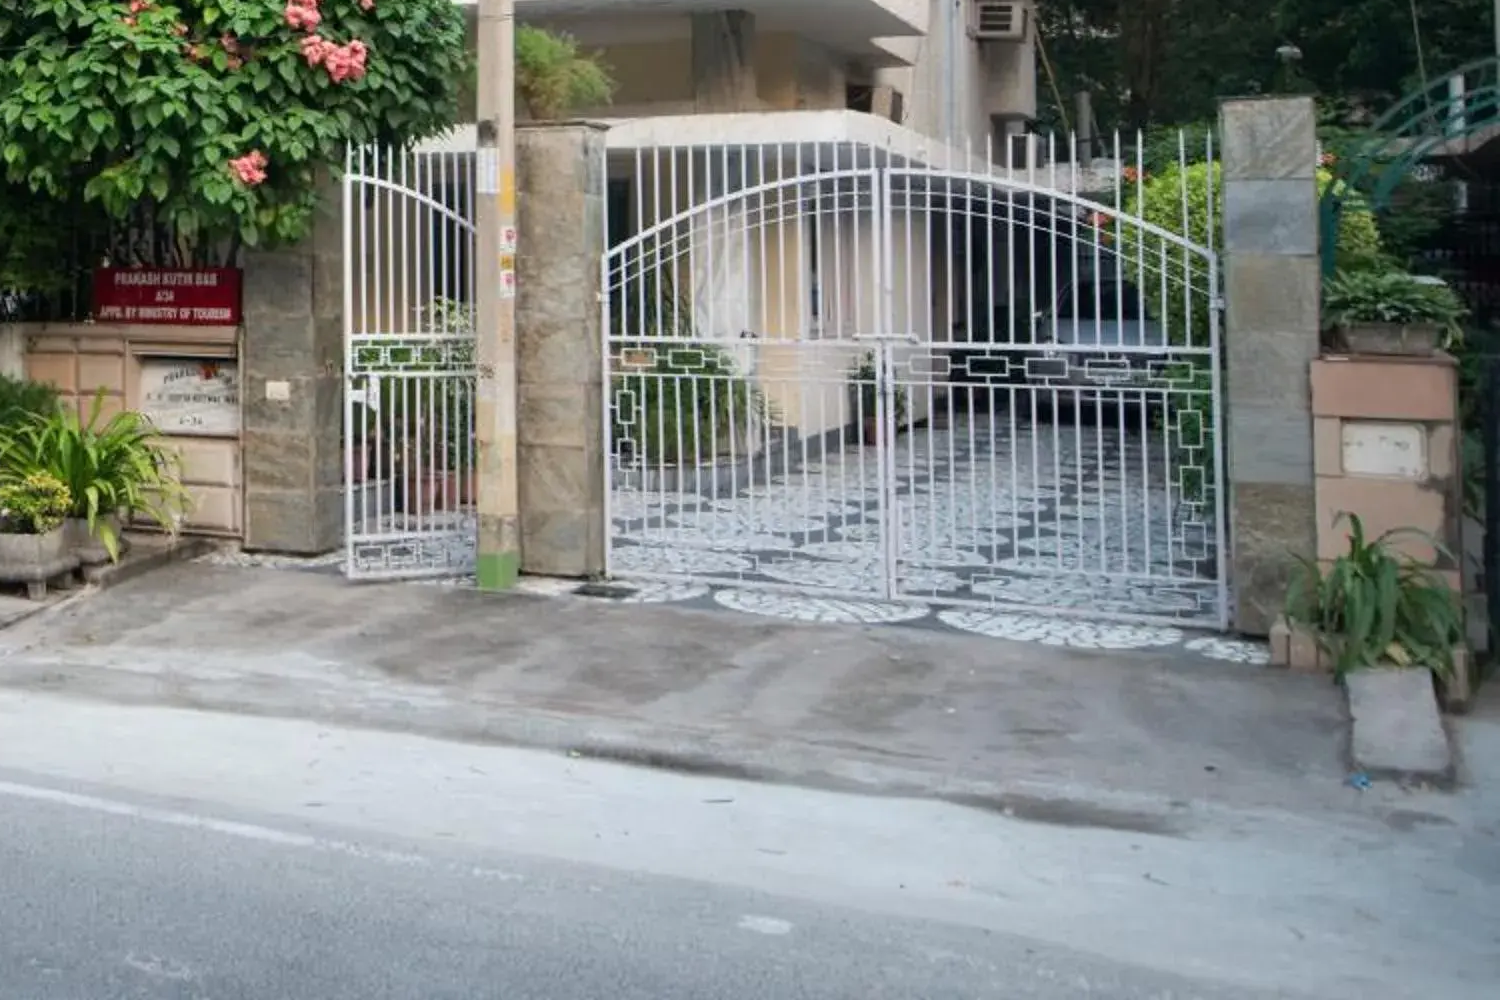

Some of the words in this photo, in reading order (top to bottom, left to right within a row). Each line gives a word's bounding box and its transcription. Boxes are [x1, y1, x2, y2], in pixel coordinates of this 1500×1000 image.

[114, 271, 161, 286] PRAKASH
[162, 271, 192, 286] KUTIR
[139, 306, 177, 319] MINISTRY
[179, 307, 190, 319] OF
[193, 307, 231, 320] TOURISM
